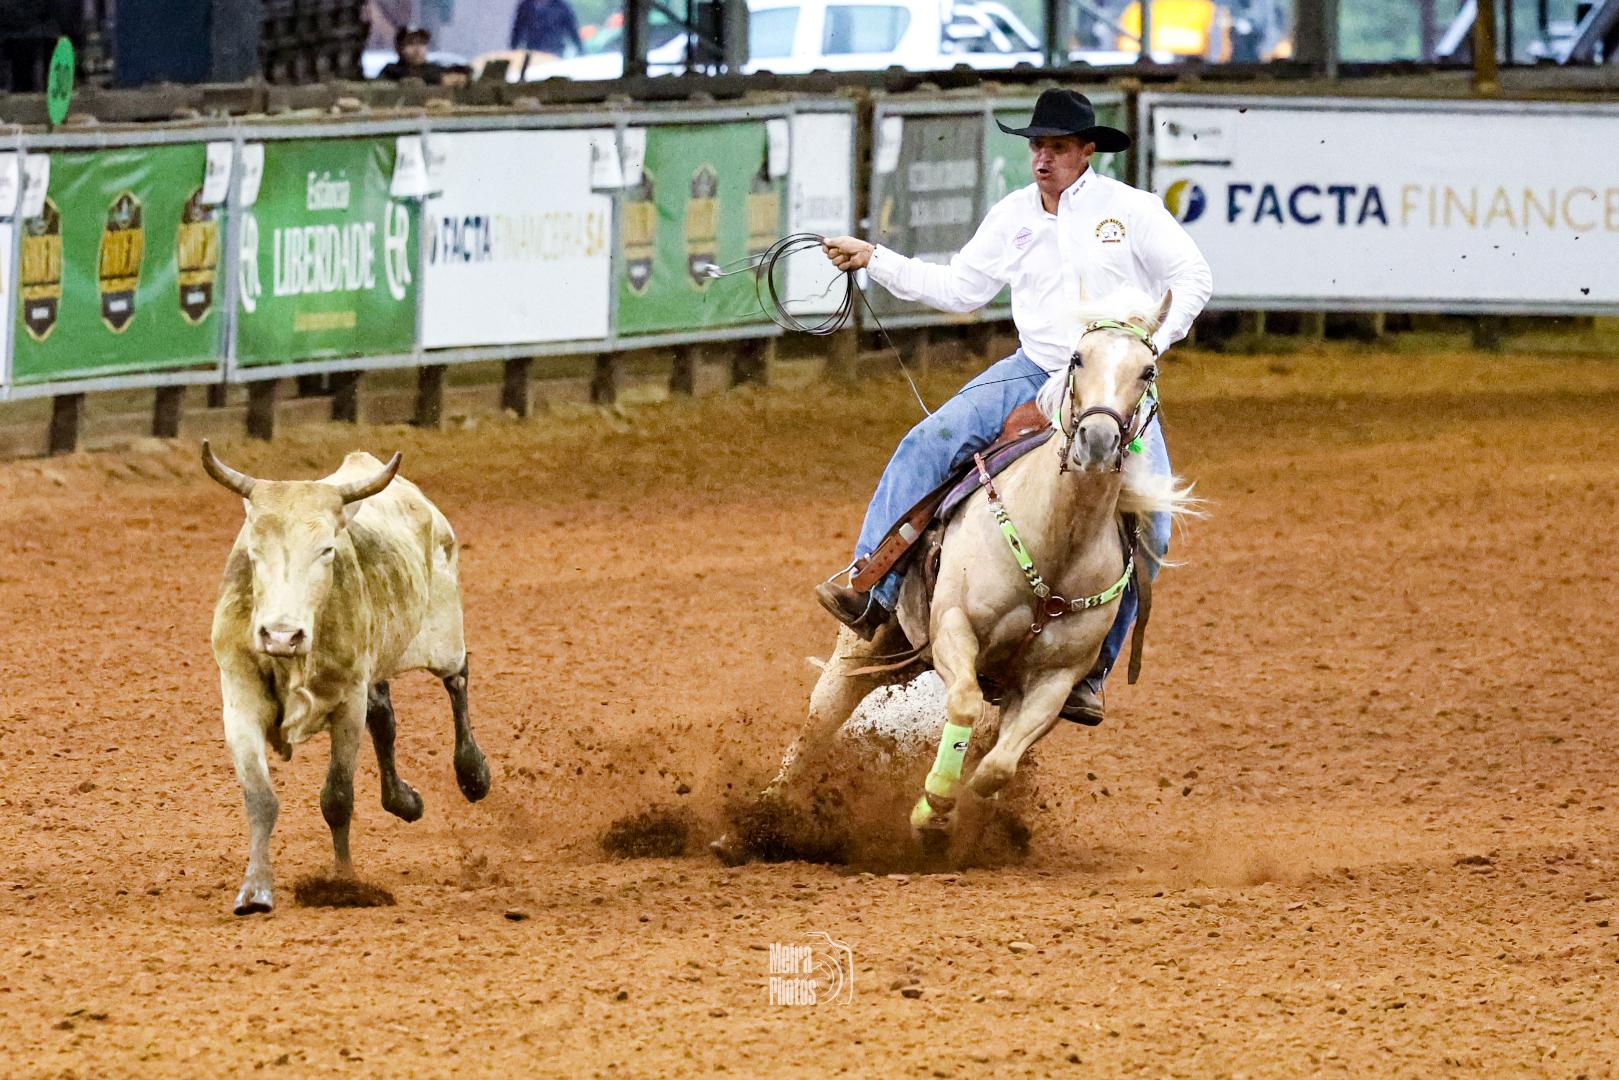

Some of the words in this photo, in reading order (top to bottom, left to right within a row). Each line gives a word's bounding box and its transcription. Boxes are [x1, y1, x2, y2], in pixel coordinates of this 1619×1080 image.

[1227, 184, 1389, 226] FACTA
[273, 221, 376, 297] LIBERDADE
[442, 216, 491, 264] FACTA
